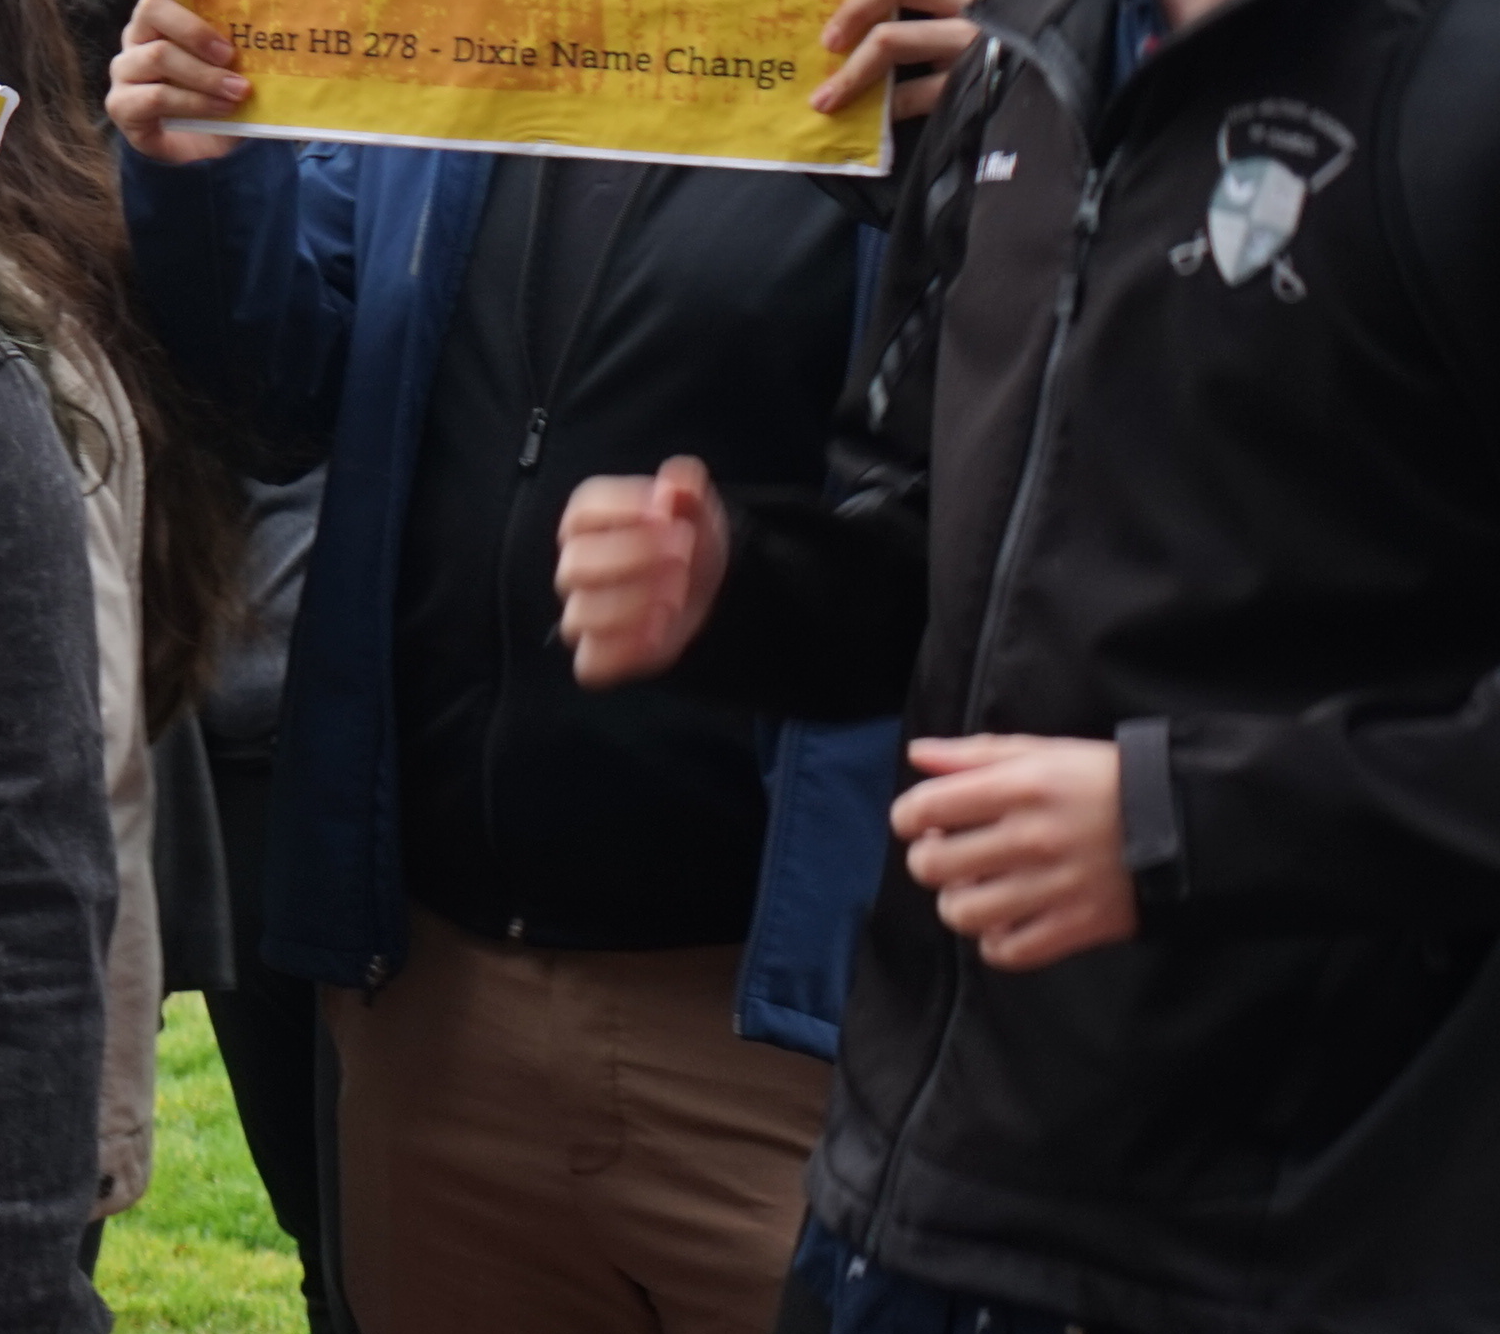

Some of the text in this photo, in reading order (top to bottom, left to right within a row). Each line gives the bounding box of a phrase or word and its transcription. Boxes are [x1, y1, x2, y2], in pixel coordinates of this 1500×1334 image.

[229, 22, 298, 52] Hear
[308, 28, 352, 56] HB
[363, 31, 418, 59] 278
[453, 36, 538, 66] Dixie
[550, 41, 652, 72] Name
[664, 46, 797, 90] Change
